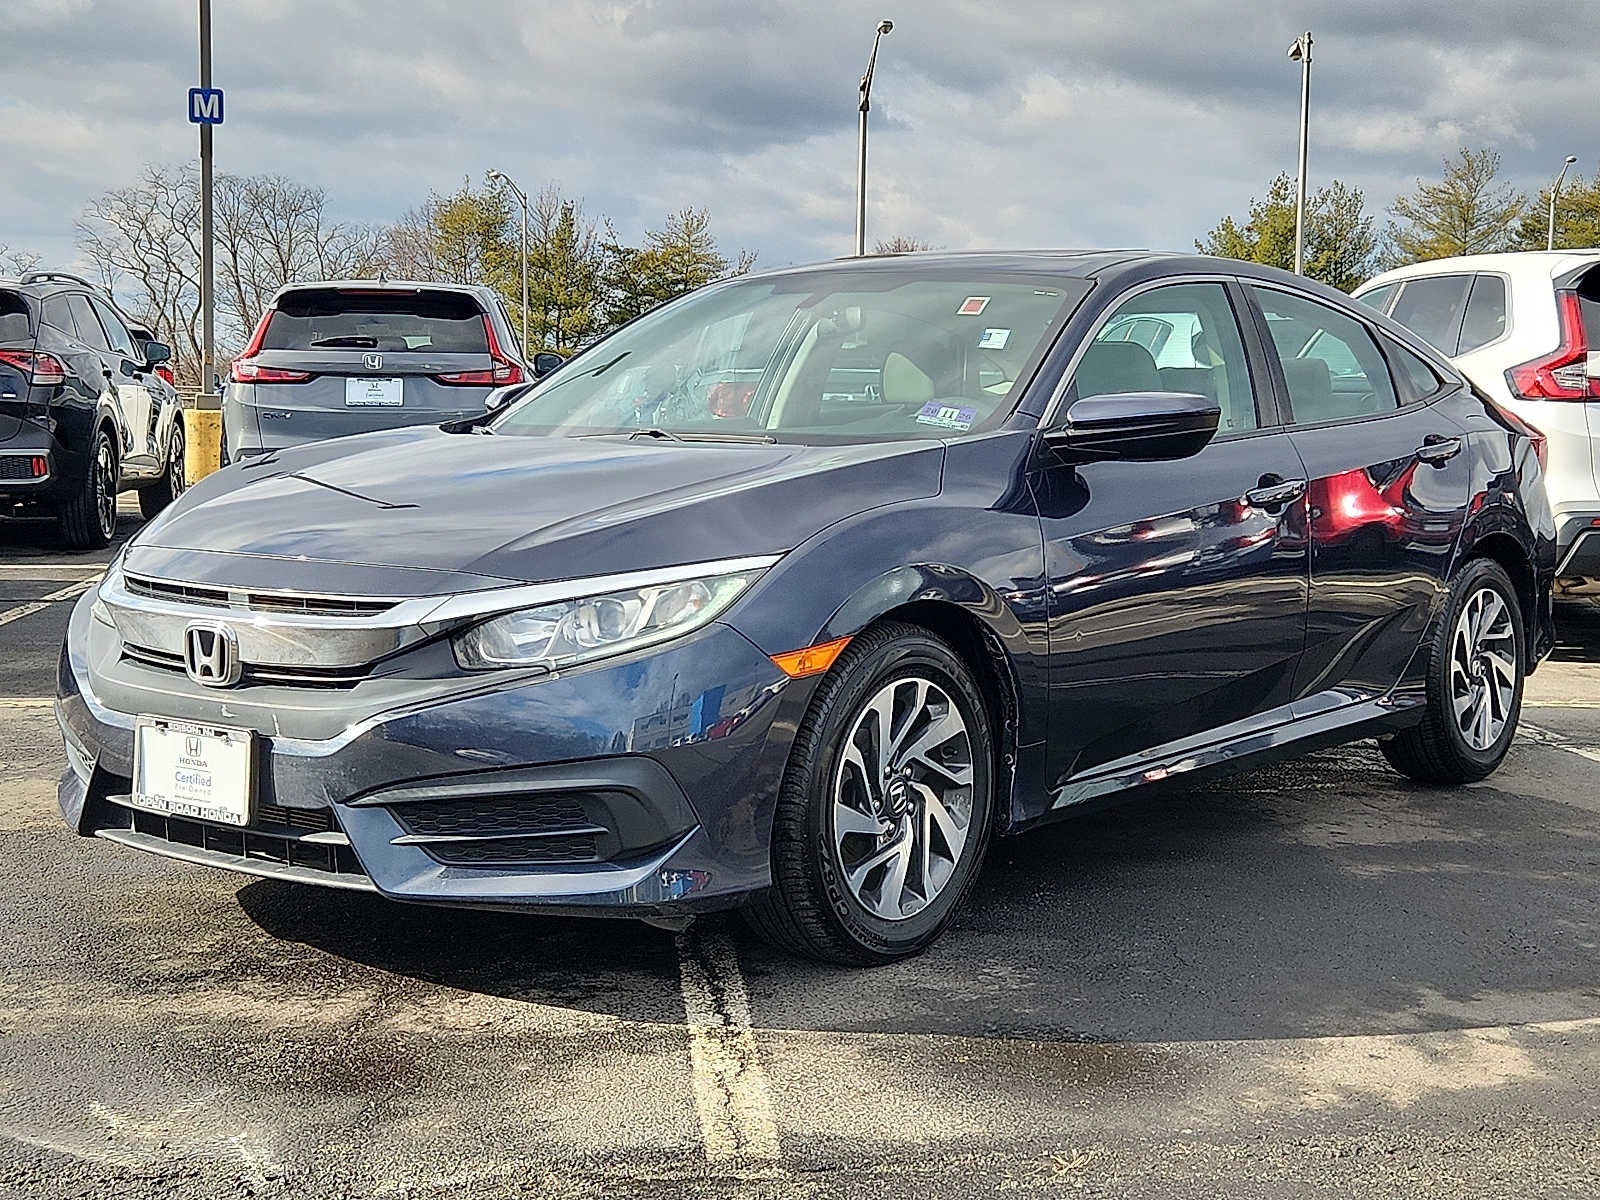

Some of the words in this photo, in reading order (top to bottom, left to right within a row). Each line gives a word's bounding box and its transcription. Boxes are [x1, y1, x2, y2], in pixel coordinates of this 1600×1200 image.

[194, 93, 219, 118] M
[941, 409, 954, 419] 11
[179, 757, 208, 768] HONDA
[175, 771, 212, 787] Certified
[138, 794, 167, 811] OPEN
[168, 801, 201, 816] ROAD
[200, 807, 242, 825] HONDA
